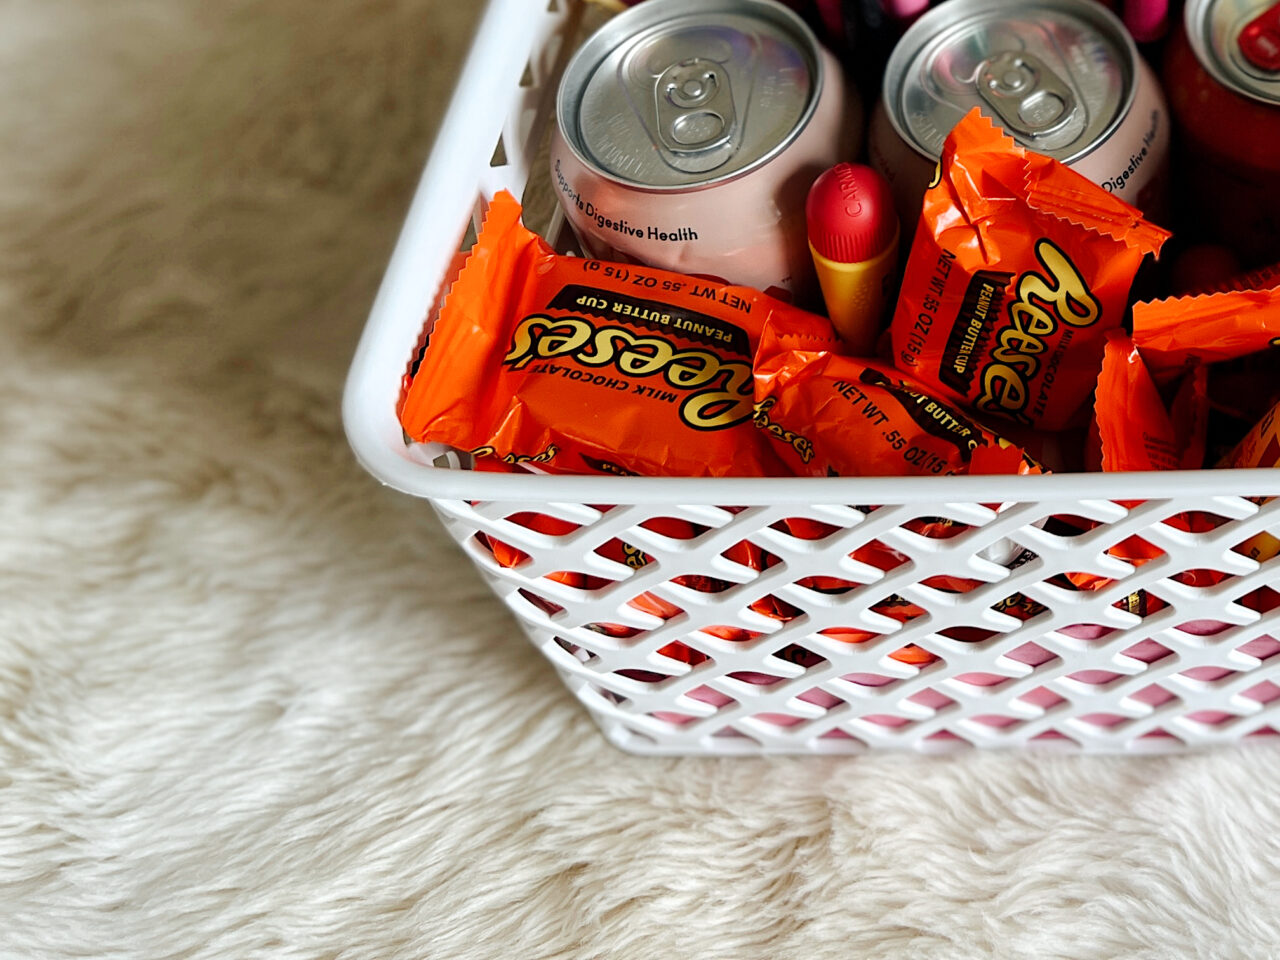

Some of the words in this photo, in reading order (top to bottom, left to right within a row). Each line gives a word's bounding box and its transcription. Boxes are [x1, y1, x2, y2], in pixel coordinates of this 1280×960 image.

[1101, 147, 1148, 193] Digestive
[554, 159, 585, 211] Supports
[585, 202, 644, 239] Digestive
[647, 226, 698, 242] Health
[583, 260, 601, 272] g)
[603, 266, 630, 282] (15
[937, 248, 957, 280] NET
[632, 273, 658, 289] OZ
[661, 280, 688, 292] .55
[690, 284, 717, 301] WT
[928, 275, 946, 297] WT
[575, 294, 609, 310] CUP
[718, 292, 752, 314] NET
[974, 282, 995, 320] PEANUT
[611, 301, 671, 325] BUTTER
[914, 312, 934, 335] OZ
[673, 319, 733, 343] PEANUT
[960, 318, 983, 354] BUTTER
[502, 313, 755, 432] Reese's
[953, 351, 970, 374] CUP
[528, 363, 630, 391] CHOCOLATE
[633, 383, 679, 404] MILK
[832, 380, 868, 406] NET
[861, 401, 890, 426] WT
[882, 429, 908, 451] .55
[903, 446, 928, 467] OZ
[924, 401, 972, 438] BUTTER
